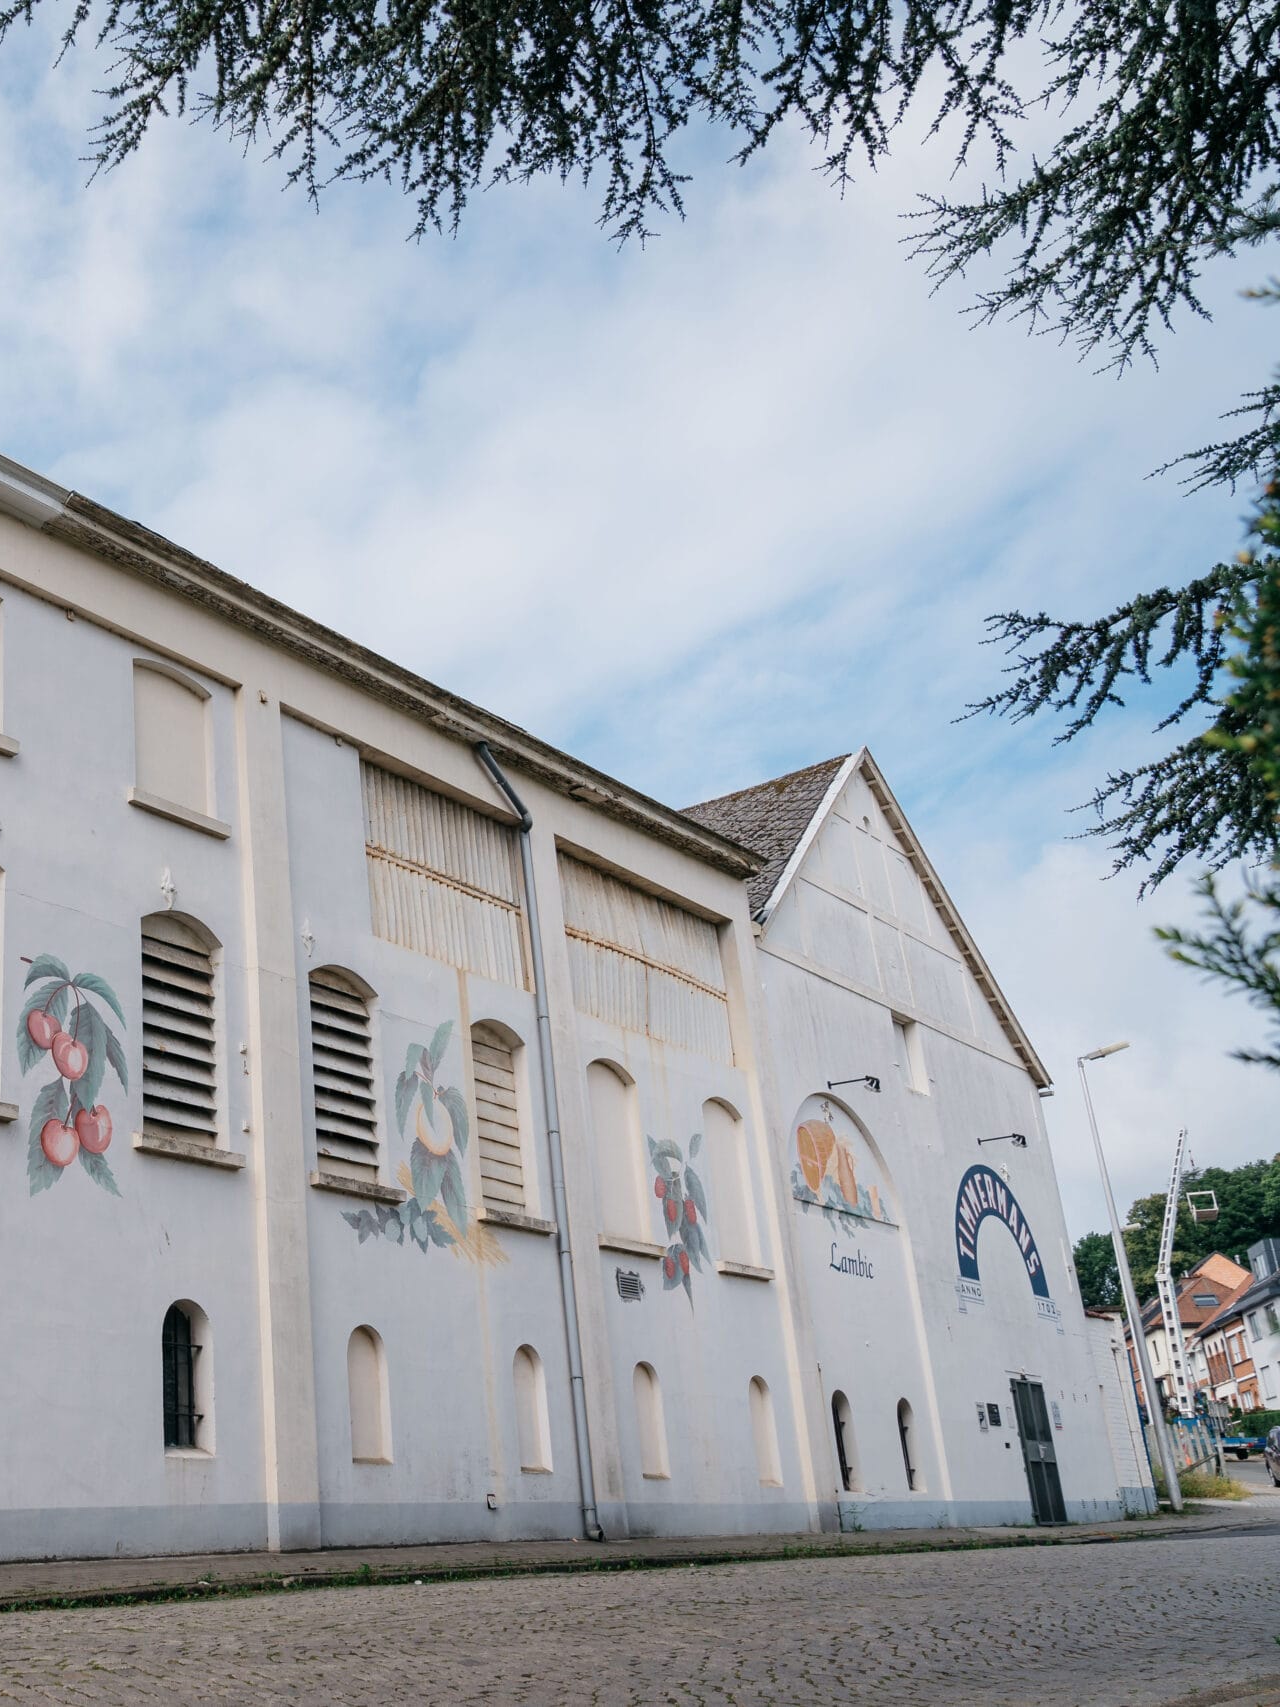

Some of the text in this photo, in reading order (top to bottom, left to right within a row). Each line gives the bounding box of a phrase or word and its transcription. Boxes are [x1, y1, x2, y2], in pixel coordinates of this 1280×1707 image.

[959, 1173, 1039, 1275] TIMMERMANS
[829, 1242, 874, 1279] Lambic
[961, 1283, 982, 1297] ANNO
